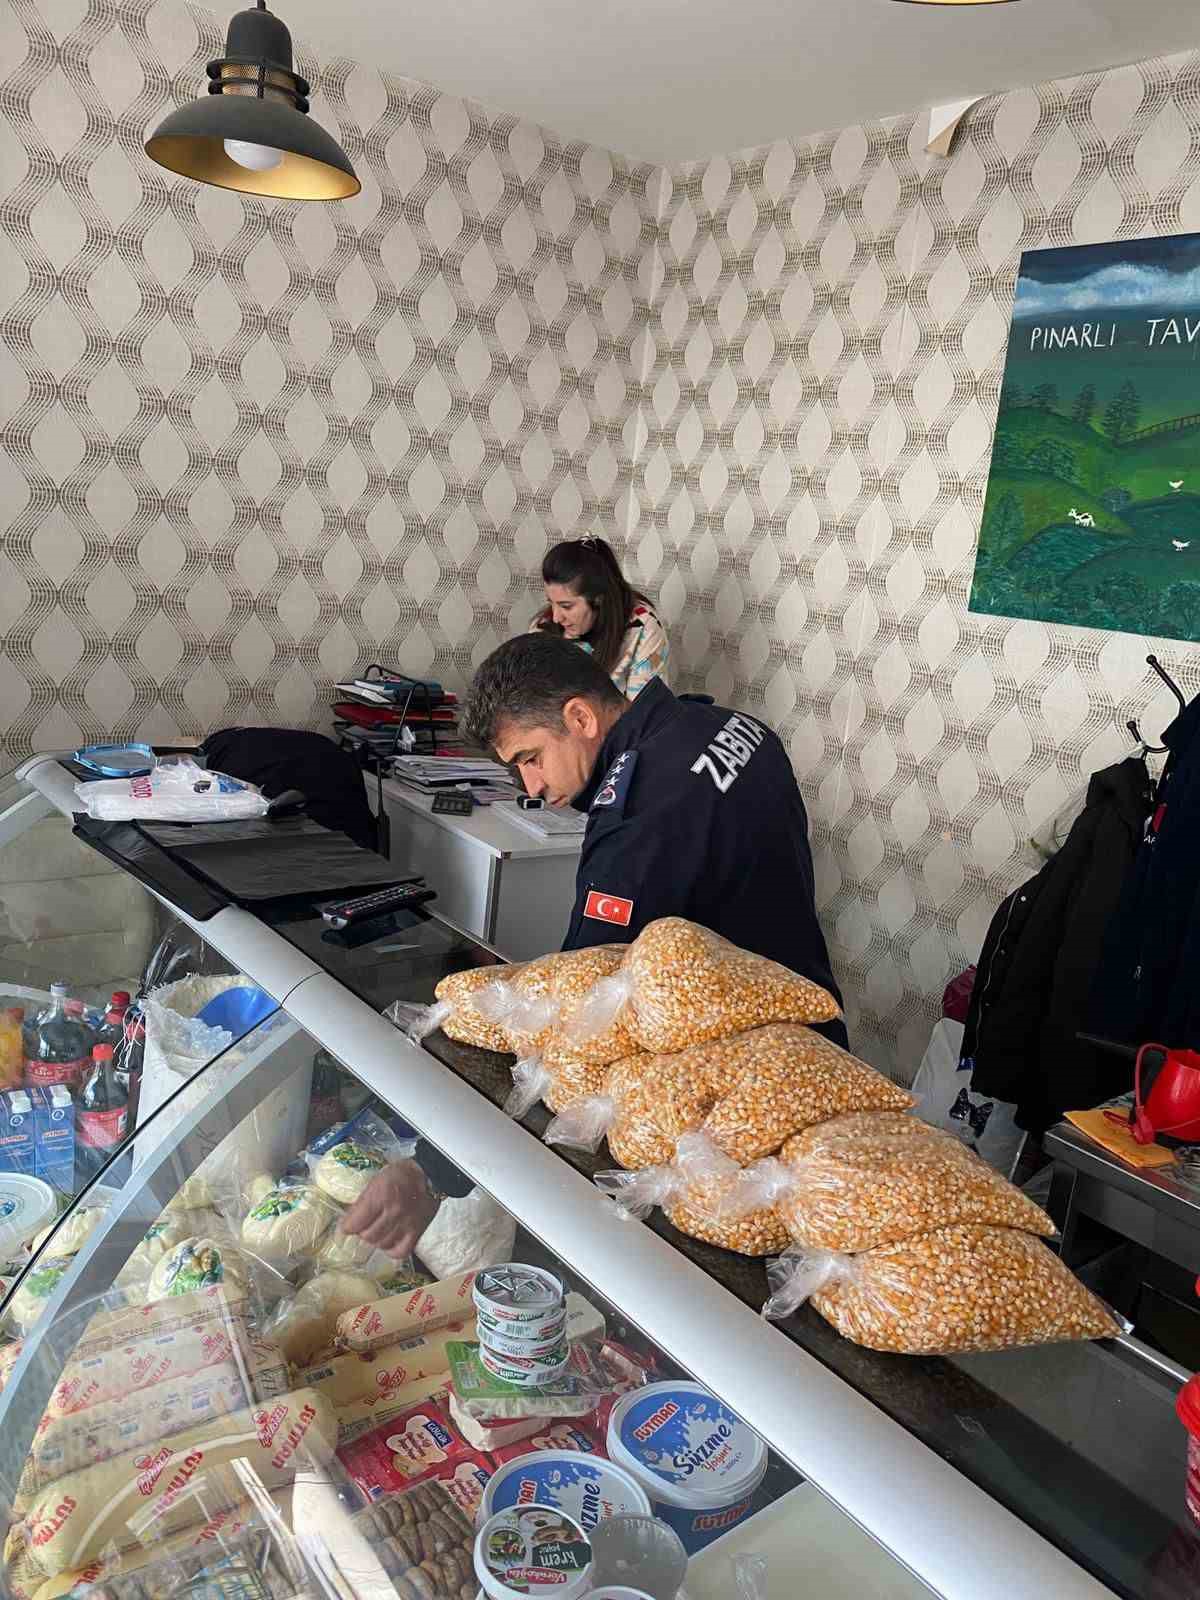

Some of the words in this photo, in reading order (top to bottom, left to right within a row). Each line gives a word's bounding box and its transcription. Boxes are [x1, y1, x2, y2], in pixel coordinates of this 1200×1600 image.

[1030, 322, 1116, 351] PINARLI
[690, 712, 765, 793] ZABITA
[673, 1424, 732, 1475] Süzme
[540, 1551, 579, 1568] krem
